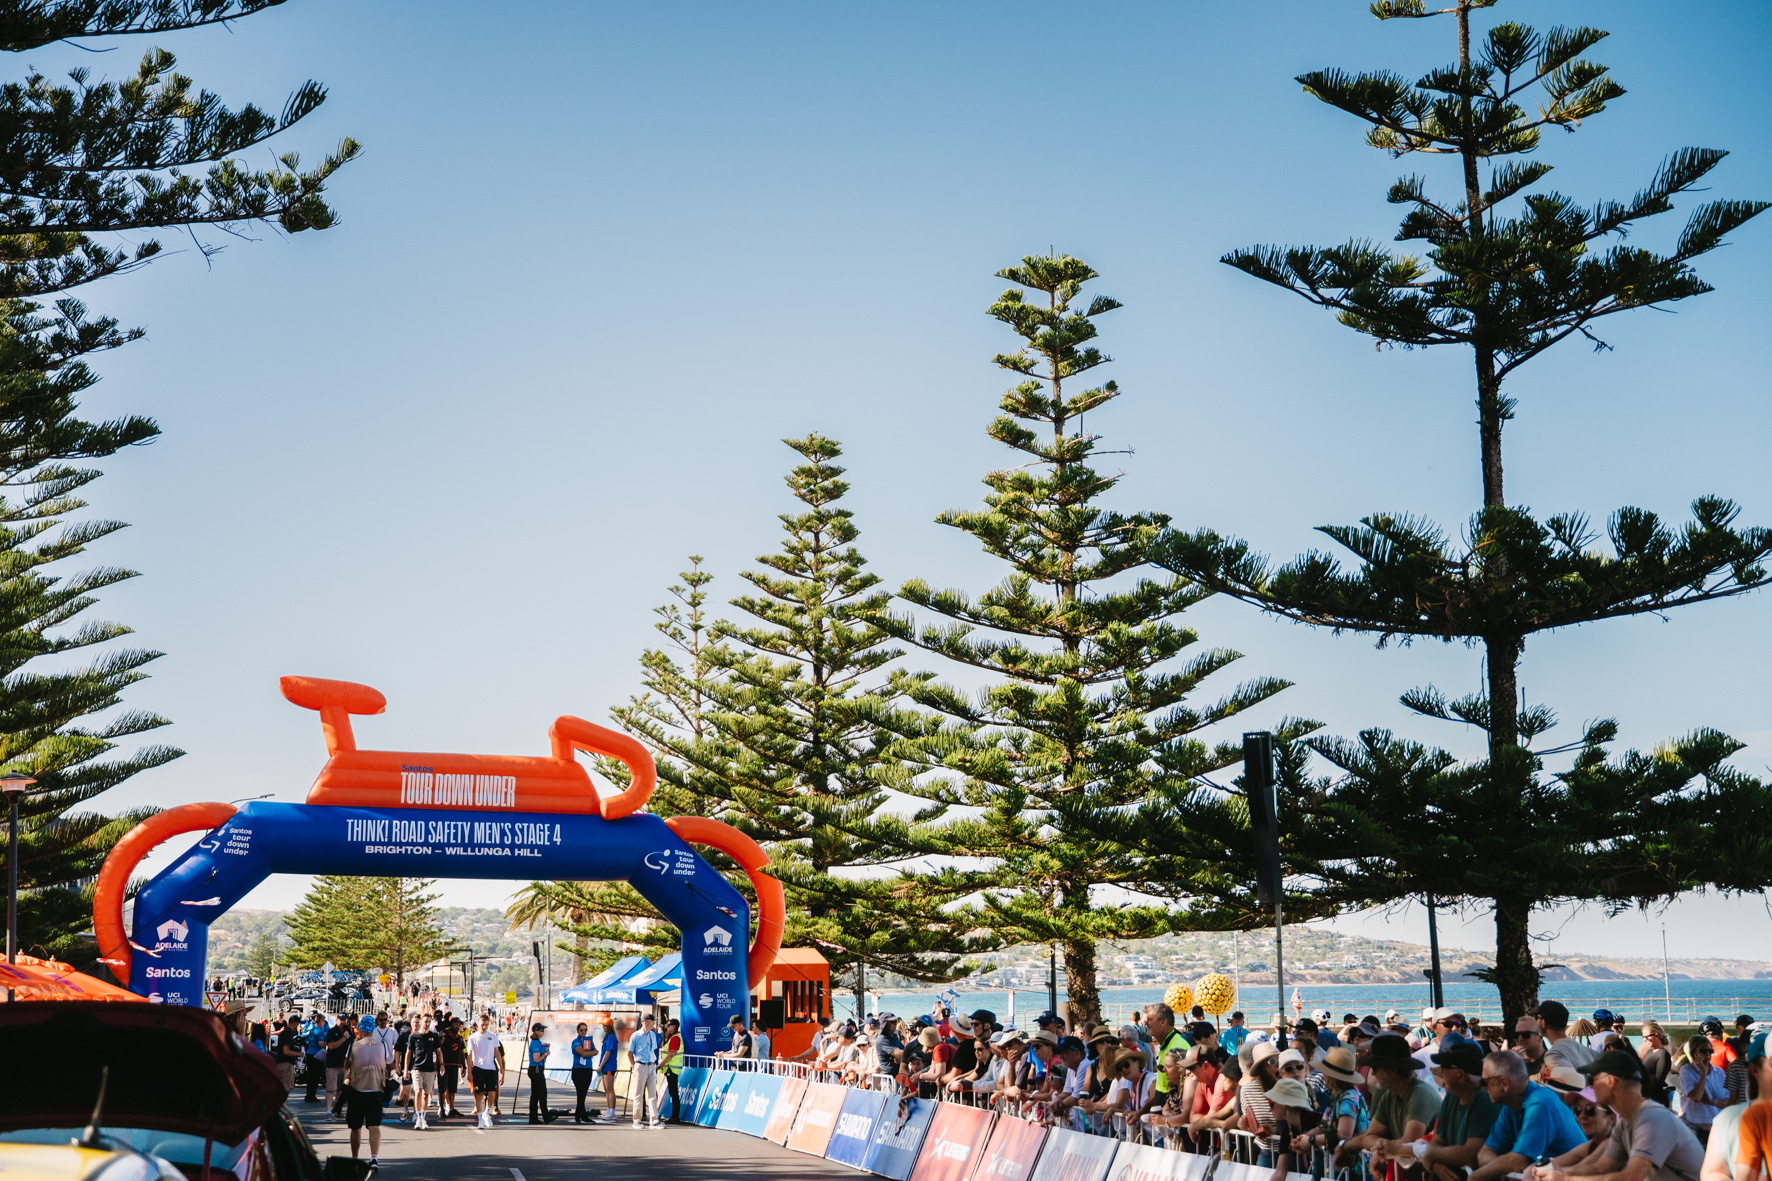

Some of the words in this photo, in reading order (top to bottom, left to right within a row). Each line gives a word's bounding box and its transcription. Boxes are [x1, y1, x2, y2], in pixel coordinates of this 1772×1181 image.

[401, 764, 434, 773] Santos
[400, 772, 433, 805] TOUR
[434, 773, 474, 806] DOWN
[475, 774, 516, 808] UNDER
[232, 834, 252, 842] tour
[346, 819, 389, 842] THINK!
[391, 820, 425, 843] ROAD
[428, 820, 471, 844] SAFETY
[514, 822, 550, 846] STAGE
[552, 823, 562, 846] 4
[227, 840, 250, 849] down
[223, 847, 249, 856] under
[365, 845, 432, 855] BRIGHTON
[445, 846, 512, 856] WILLUNGA
[514, 848, 542, 857] HILL
[674, 849, 694, 858] Santos
[675, 861, 695, 869] down
[145, 966, 191, 978] Santos
[696, 969, 736, 980] Santos
[708, 1086, 739, 1112] Santos
[744, 1089, 770, 1118] Santos
[835, 1112, 873, 1141] SHIMANO
